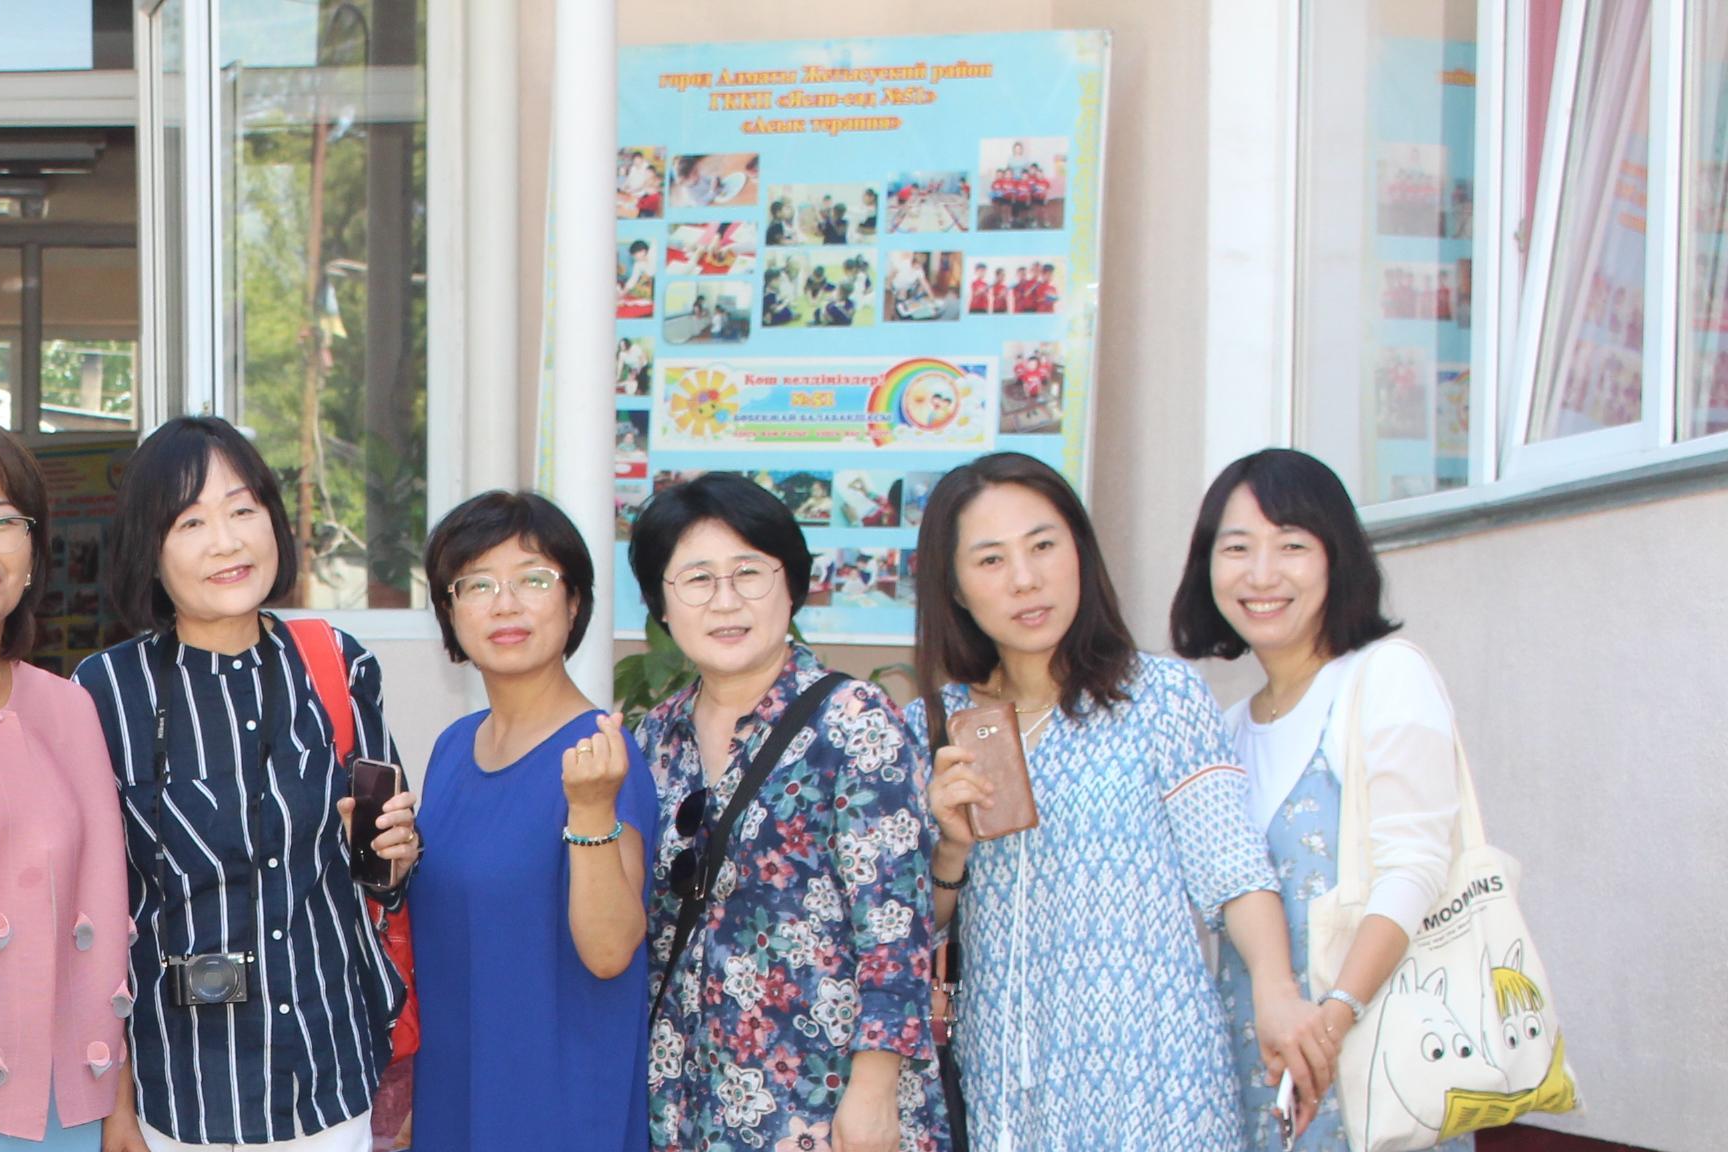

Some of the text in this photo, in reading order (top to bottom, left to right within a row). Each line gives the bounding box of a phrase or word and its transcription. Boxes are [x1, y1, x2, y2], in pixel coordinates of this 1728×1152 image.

[716, 67, 798, 86] Алматы
[930, 60, 992, 84] район
[709, 91, 772, 111] ГККП
